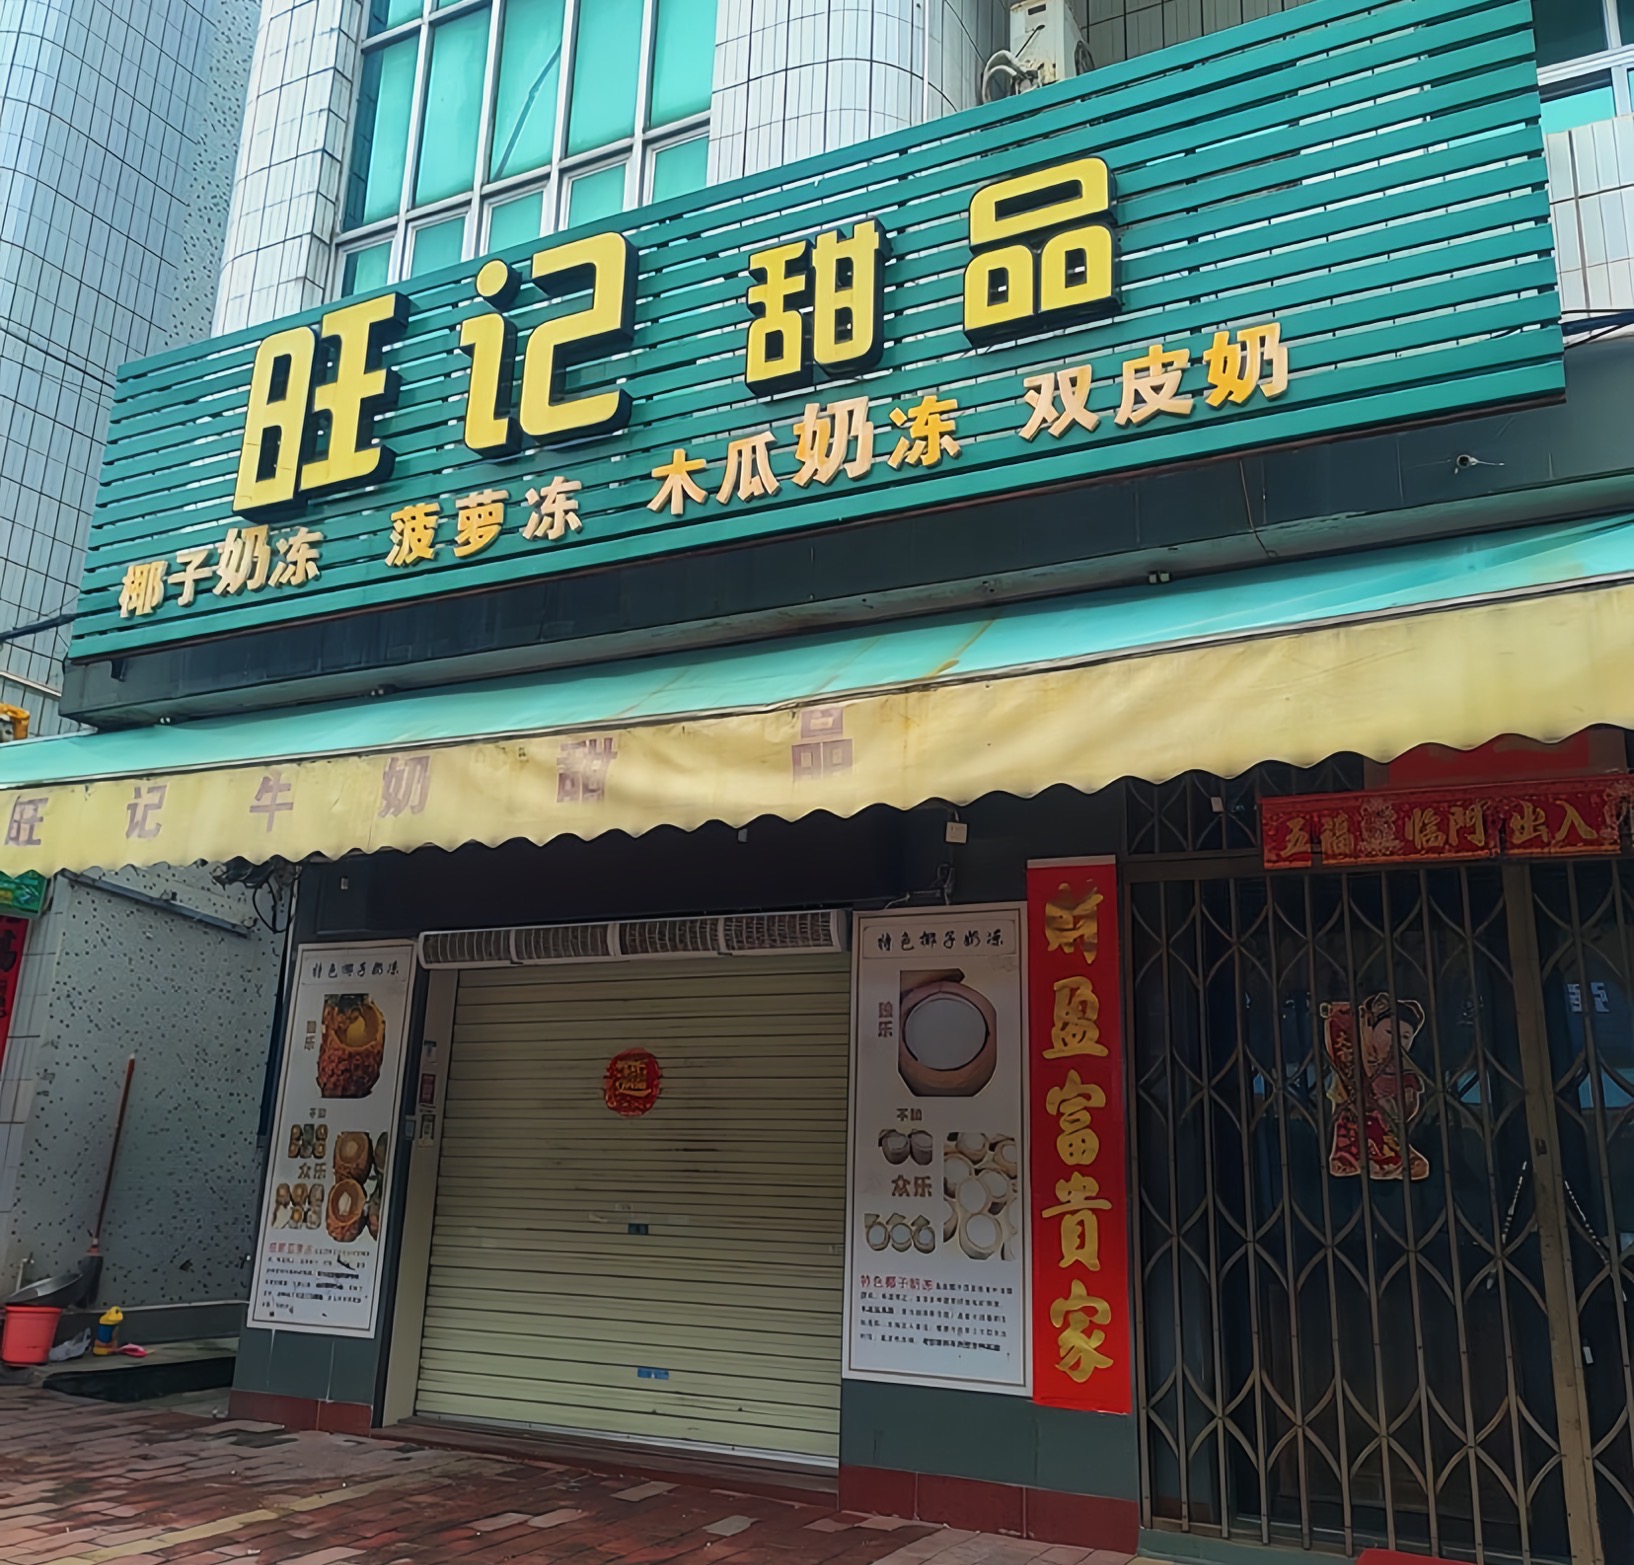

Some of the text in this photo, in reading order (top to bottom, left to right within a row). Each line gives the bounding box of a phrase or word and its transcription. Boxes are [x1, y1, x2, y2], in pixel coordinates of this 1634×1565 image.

[118, 322, 1291, 618] 椰子奶冻 菠萝冻 木瓜奶冻 双皮奶
[233, 157, 1119, 516] 旺记甜品
[891, 1175, 932, 1197] 众乐
